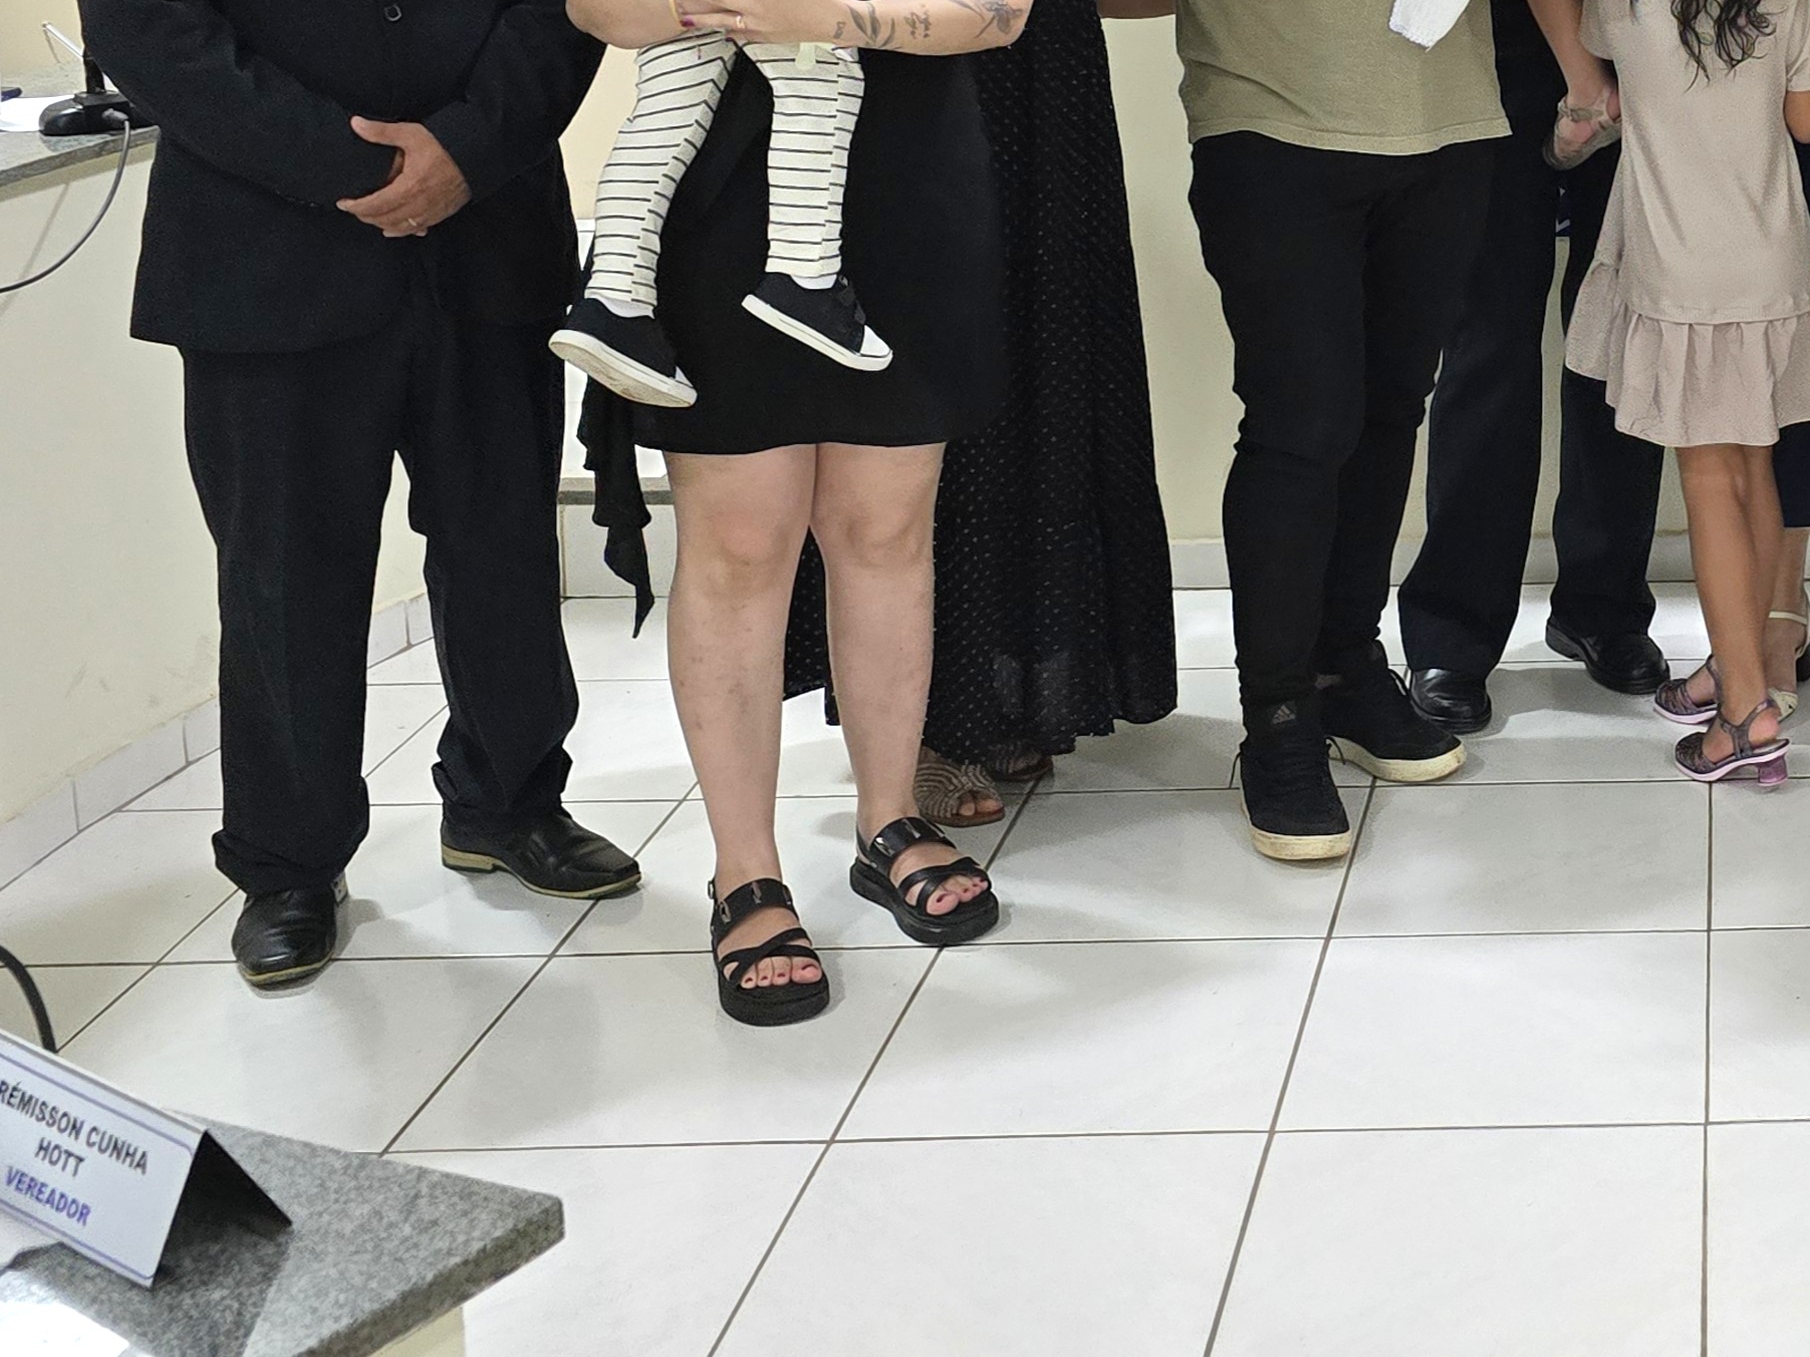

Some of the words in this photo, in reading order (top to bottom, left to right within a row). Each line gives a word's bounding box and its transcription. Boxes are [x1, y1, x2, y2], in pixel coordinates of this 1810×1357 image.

[34, 1137, 86, 1177] HOTT
[86, 1126, 148, 1175] CUNHA
[5, 1165, 92, 1225] VEREADOR
